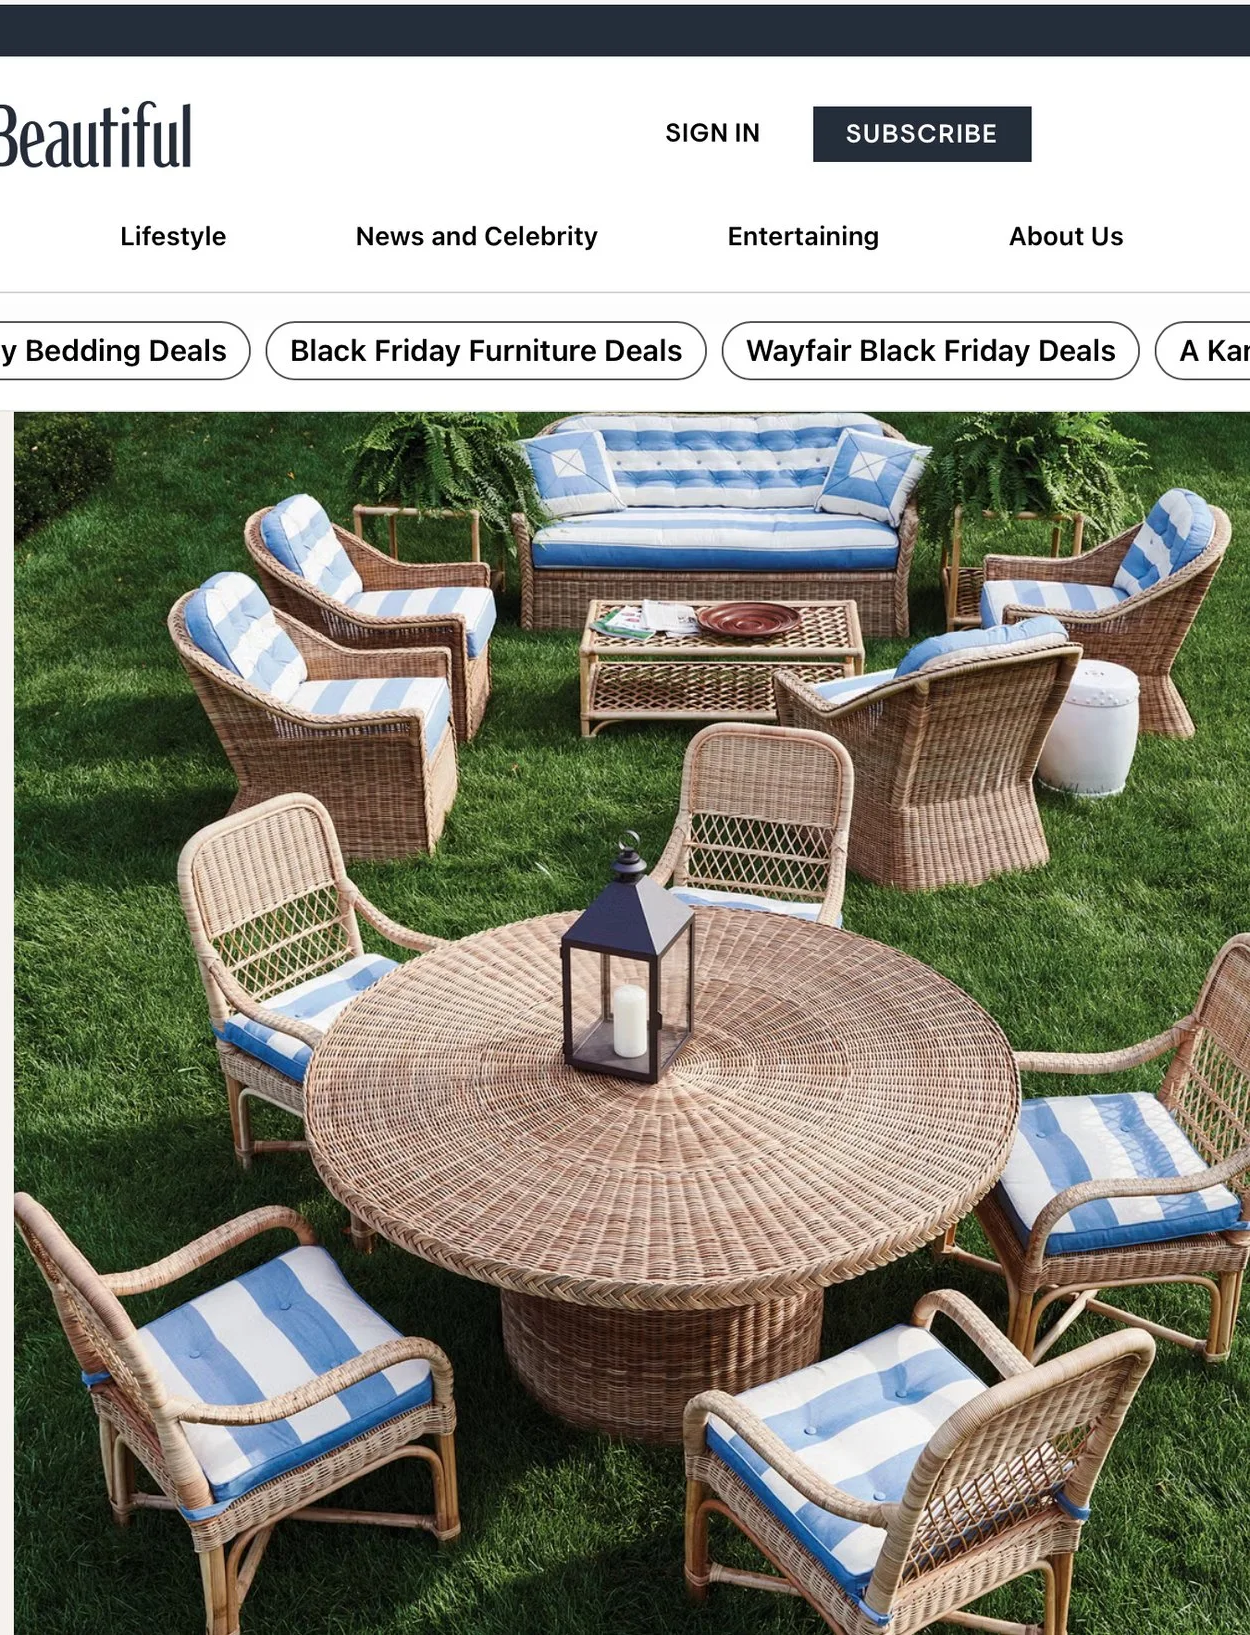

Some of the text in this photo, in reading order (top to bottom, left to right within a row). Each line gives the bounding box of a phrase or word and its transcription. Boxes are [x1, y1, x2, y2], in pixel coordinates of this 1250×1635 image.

[665, 122, 760, 143] SIGN IN
[846, 123, 997, 144] SUBSCRIBE
[121, 224, 227, 251] Lifestyle
[356, 224, 599, 251] News and Celebrity
[728, 224, 879, 251] Entertaining
[1008, 225, 1124, 247] About Us
[26, 337, 141, 368] Bedding
[149, 338, 227, 362] Deals
[291, 337, 683, 368] Black Friday Furniture Deals
[745, 337, 1116, 368] Wayfair Black Friday Deals
[1179, 338, 1200, 362] A
